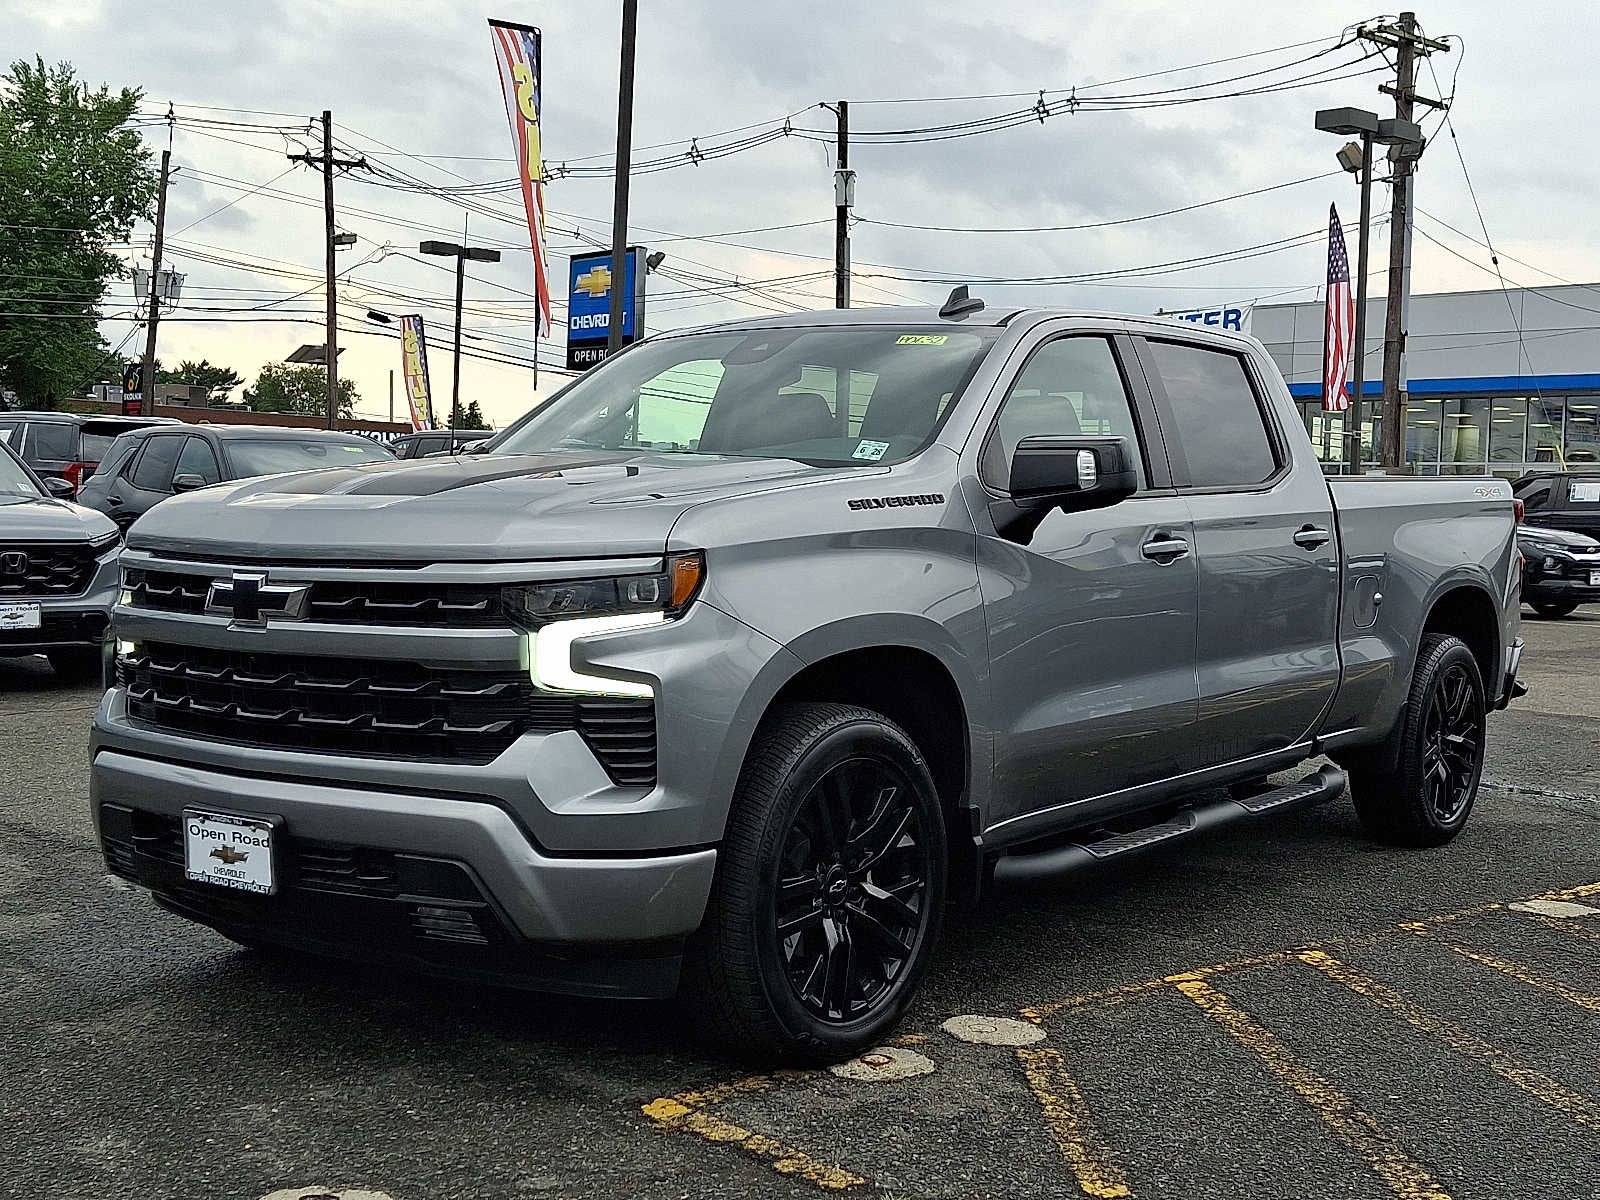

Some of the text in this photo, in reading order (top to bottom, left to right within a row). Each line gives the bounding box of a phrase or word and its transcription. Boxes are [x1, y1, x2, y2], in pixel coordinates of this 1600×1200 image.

[571, 311, 627, 330] CHEVROT
[574, 349, 597, 362] OPEN
[847, 493, 945, 511] SILVERADO
[189, 824, 269, 849] Open Road
[213, 866, 246, 880] CHEVROLET
[189, 872, 270, 894] OPEN ROAD CHEVROLET
